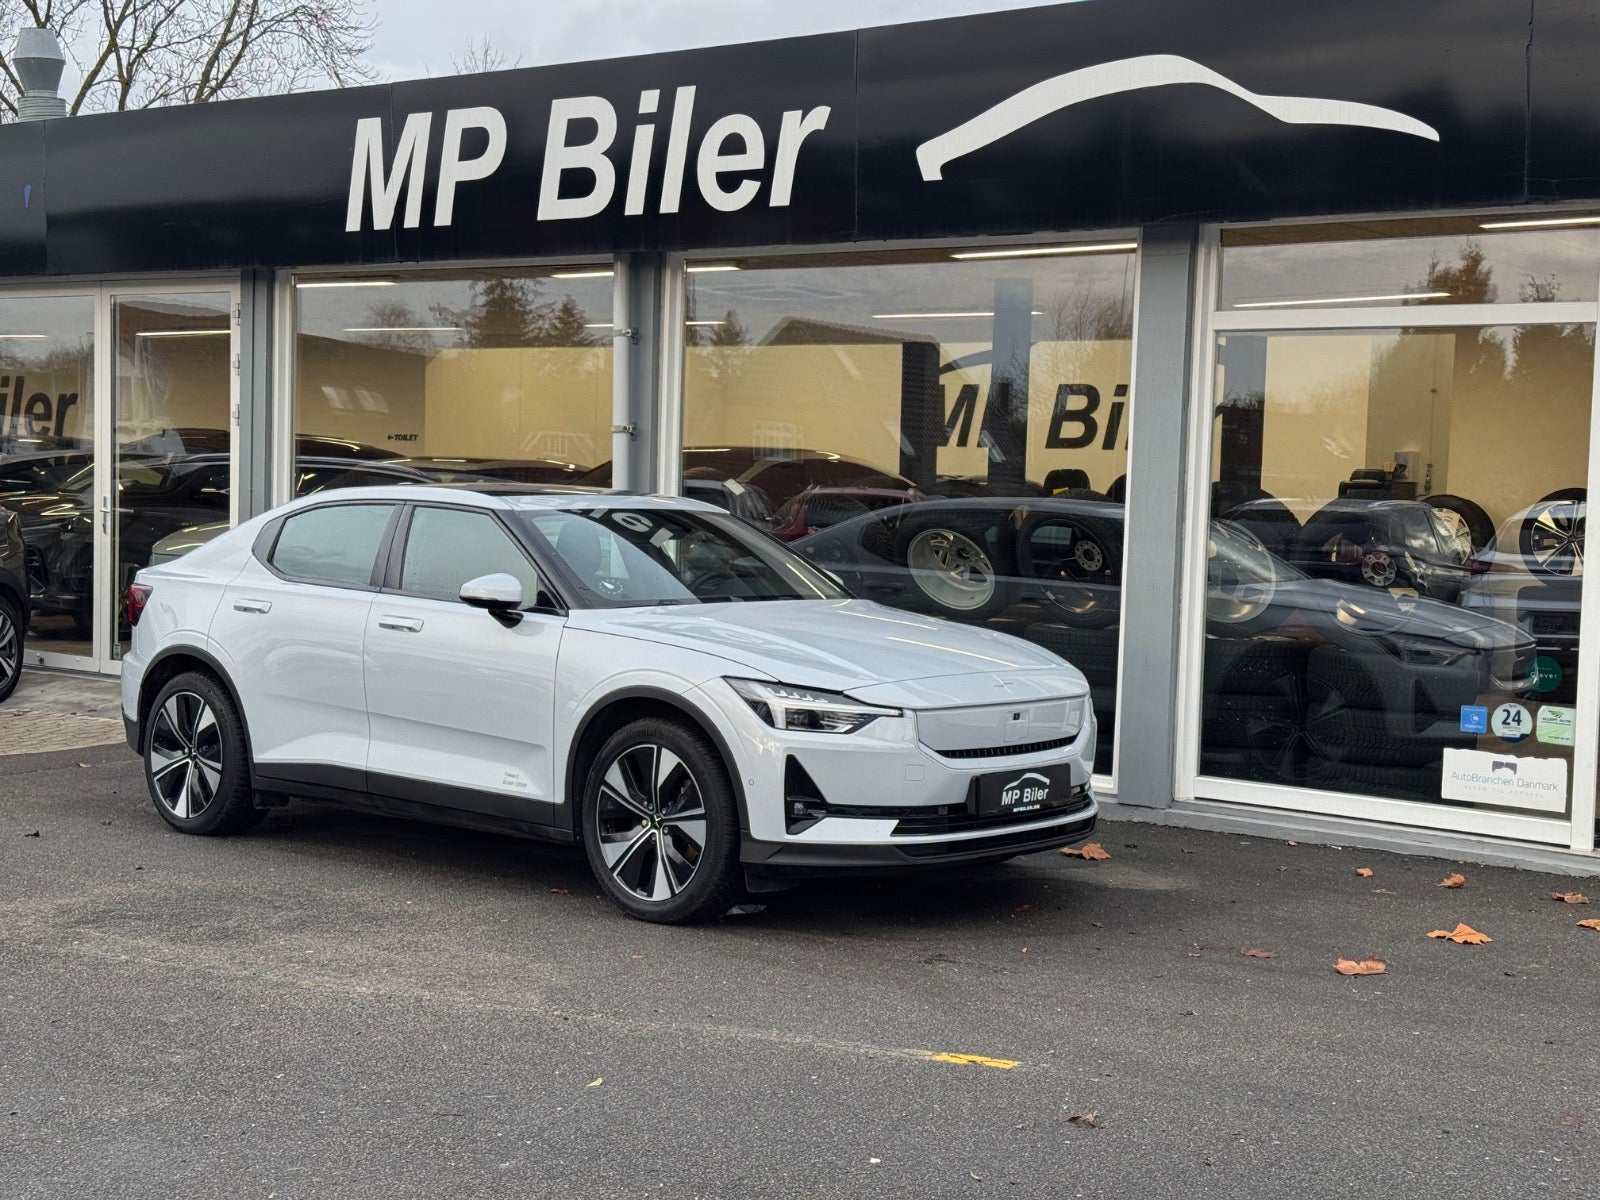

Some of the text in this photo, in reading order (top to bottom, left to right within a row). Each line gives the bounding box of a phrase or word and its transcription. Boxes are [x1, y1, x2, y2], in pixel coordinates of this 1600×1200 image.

[345, 85, 832, 233] MP Biler
[1502, 709, 1522, 726] 24
[1451, 771, 1559, 792] AutoBranchen Danmark
[1002, 787, 1049, 805] MP Biler
